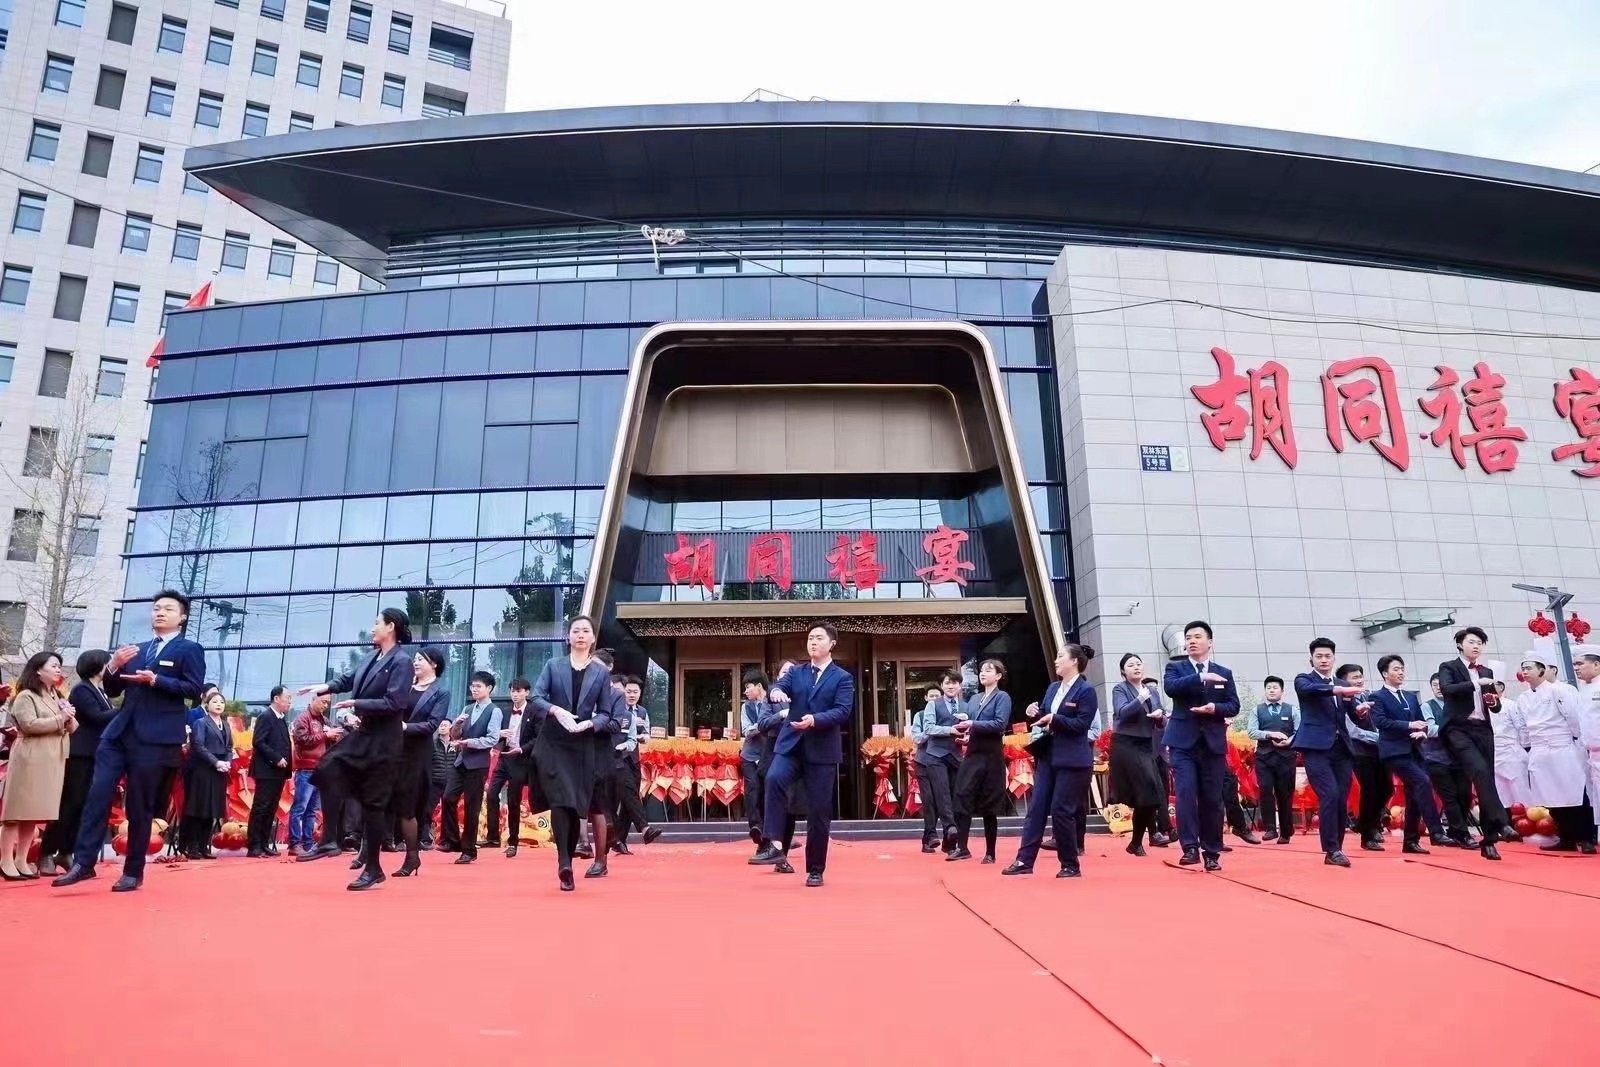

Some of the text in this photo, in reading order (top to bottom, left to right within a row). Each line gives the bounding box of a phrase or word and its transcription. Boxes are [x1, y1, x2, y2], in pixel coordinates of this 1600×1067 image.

[1146, 458, 1167, 467] 5号院
[663, 525, 976, 592] 胡同禧宴
